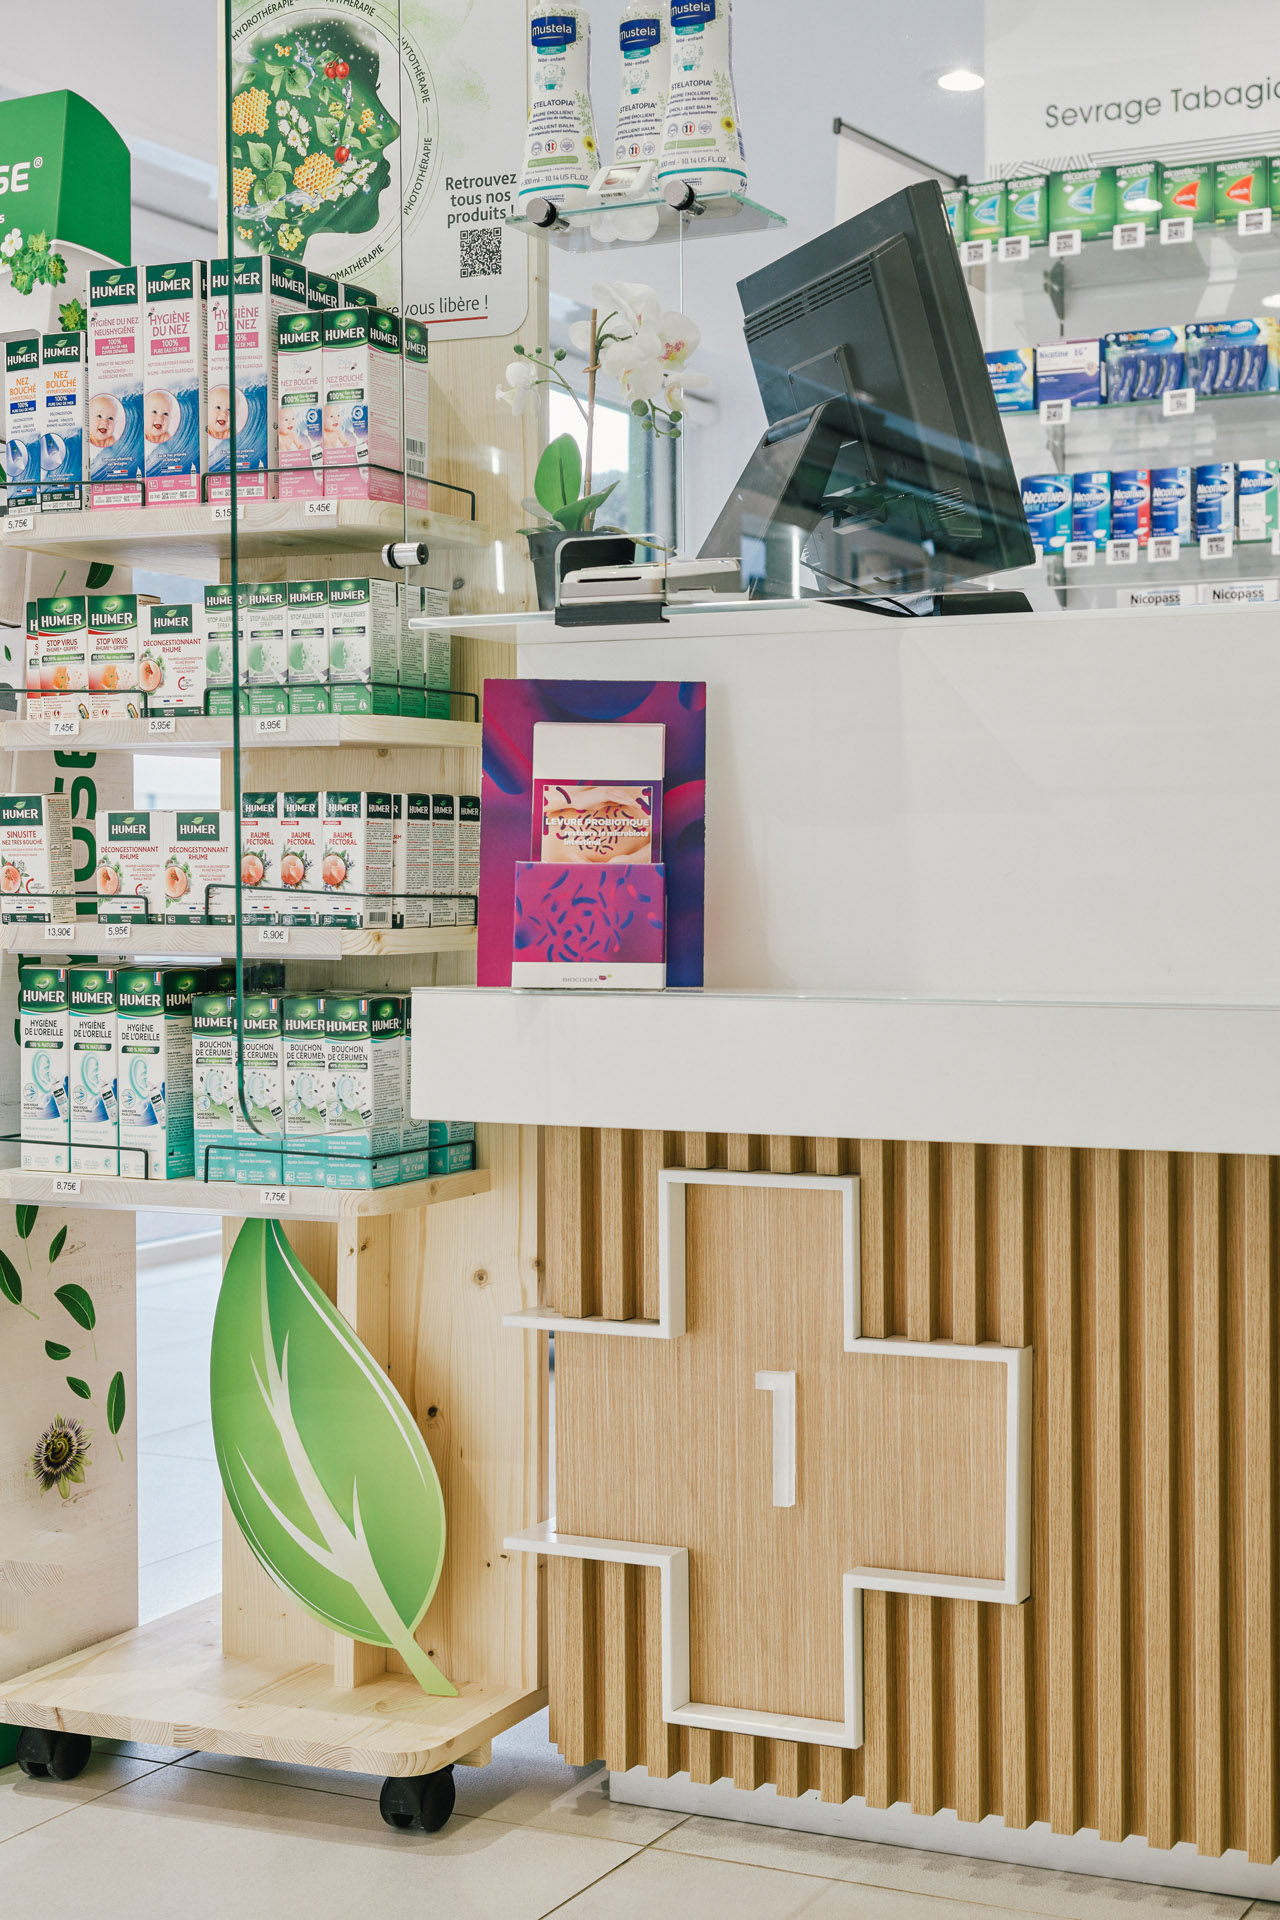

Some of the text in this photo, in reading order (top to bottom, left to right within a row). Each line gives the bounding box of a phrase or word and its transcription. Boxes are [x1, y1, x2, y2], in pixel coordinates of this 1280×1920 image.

[671, 2, 711, 16] mustela
[532, 24, 572, 37] mustela
[619, 26, 657, 40] mustela
[1045, 96, 1162, 129] Sevrage
[404, 137, 433, 216] PHOTOTHÉRAPIE
[445, 173, 517, 191] Retrouvez
[450, 191, 511, 207] tous nos
[447, 206, 507, 229] produits
[147, 277, 191, 294] HUMER
[271, 273, 305, 296] HUMER
[91, 283, 136, 300] HUMER
[307, 289, 338, 309] HUMER
[439, 296, 480, 315] libère
[484, 294, 488, 310] !
[90, 316, 140, 328] HYGIÈNE DU NEZ
[149, 310, 191, 326] HYGIÈNE
[236, 319, 257, 330] NEZ
[152, 323, 188, 337] DU NEZ
[325, 326, 366, 341] HUMER
[280, 331, 320, 345] HUMER
[369, 327, 398, 347] HUMER
[161, 339, 179, 347] 100%
[43, 345, 79, 359] HUMER
[153, 346, 164, 354] PURE
[1039, 351, 1068, 359] Nicotine
[7, 352, 38, 366] HUMER
[53, 370, 69, 379] NEZ
[326, 372, 364, 384] NEZ BOUCHÉ
[16, 377, 30, 386] NEZ
[45, 377, 77, 389] BOUCHÉ
[280, 377, 319, 388] NEZ BOUCHÉ
[9, 384, 37, 396] BOUCHÉ
[284, 394, 299, 404] 100%
[329, 391, 345, 400] 100%
[308, 503, 331, 513] 5,45€
[8, 518, 28, 529] 5,75€
[249, 593, 283, 605] HUMER
[289, 592, 324, 603] HUMER
[330, 590, 365, 601] HUMER
[1130, 593, 1181, 606] Nicopass
[1212, 588, 1265, 602] Nicopass
[91, 612, 133, 626] HUMER
[342, 610, 366, 618] ALLERGIES
[41, 613, 82, 628] HUMER
[153, 615, 189, 628] HUMER
[46, 638, 78, 647] STOP VIRUS
[96, 637, 128, 646] STOP VIRUS
[143, 638, 202, 647] DÉCONGESTIONNANT
[54, 723, 75, 733] 7,45€
[150, 721, 171, 730] 5,95€
[259, 719, 282, 730] 8,95€
[245, 803, 275, 813] HUMER
[286, 803, 316, 813] HUMER
[328, 803, 359, 813] HUMER
[368, 804, 390, 813] HUMER
[409, 805, 429, 815] HUMER
[433, 806, 453, 815] HUMER
[460, 807, 479, 816] HUMER
[2, 808, 39, 820] HUMER
[545, 818, 649, 827] LEVURE PROBIOTIQUE
[6, 830, 37, 839] SINUSITE
[111, 824, 147, 835] HUMER
[180, 824, 216, 835] HUMER
[606, 829, 649, 837] microbiote
[250, 831, 270, 839] BAUME
[290, 831, 311, 839] BAUME
[333, 831, 353, 839] BAUME
[11, 838, 23, 846] TRÈS
[22, 837, 43, 845] BOUCHÉ
[246, 838, 275, 846] PECTORAL
[286, 838, 316, 846] PECTORAL
[328, 838, 358, 846] PECTORAL
[100, 845, 159, 853] DÉCONGESTIONNANT
[168, 845, 229, 853] DÉCONGESTIONNANT
[47, 927, 72, 936] 13,90€
[107, 926, 129, 936] 5,95€
[262, 930, 284, 940] 5,90€
[23, 989, 65, 1003] HUMER
[71, 991, 113, 1005] HUMER
[119, 993, 161, 1007] HUMER
[30, 1018, 57, 1028] HYGIÈNE
[79, 1020, 106, 1030] HYGIÈNE
[127, 1022, 154, 1032] HYGIÈNE
[285, 1019, 326, 1031] HUMER
[326, 1020, 368, 1032] HUMER
[372, 1017, 399, 1029] HUMER
[24, 1028, 64, 1037] DE L'OREILLE
[73, 1030, 112, 1039] DE L'OREILLE
[121, 1032, 160, 1042] DE L'OREILLE
[331, 1045, 364, 1053] BOUCHON
[247, 1051, 278, 1059] CÉRUMEN
[327, 1053, 368, 1061] DE CÉRUMEN
[56, 1181, 76, 1191] 8,75€
[264, 1192, 286, 1202] 7,75€
[754, 1369, 797, 1508] 1
